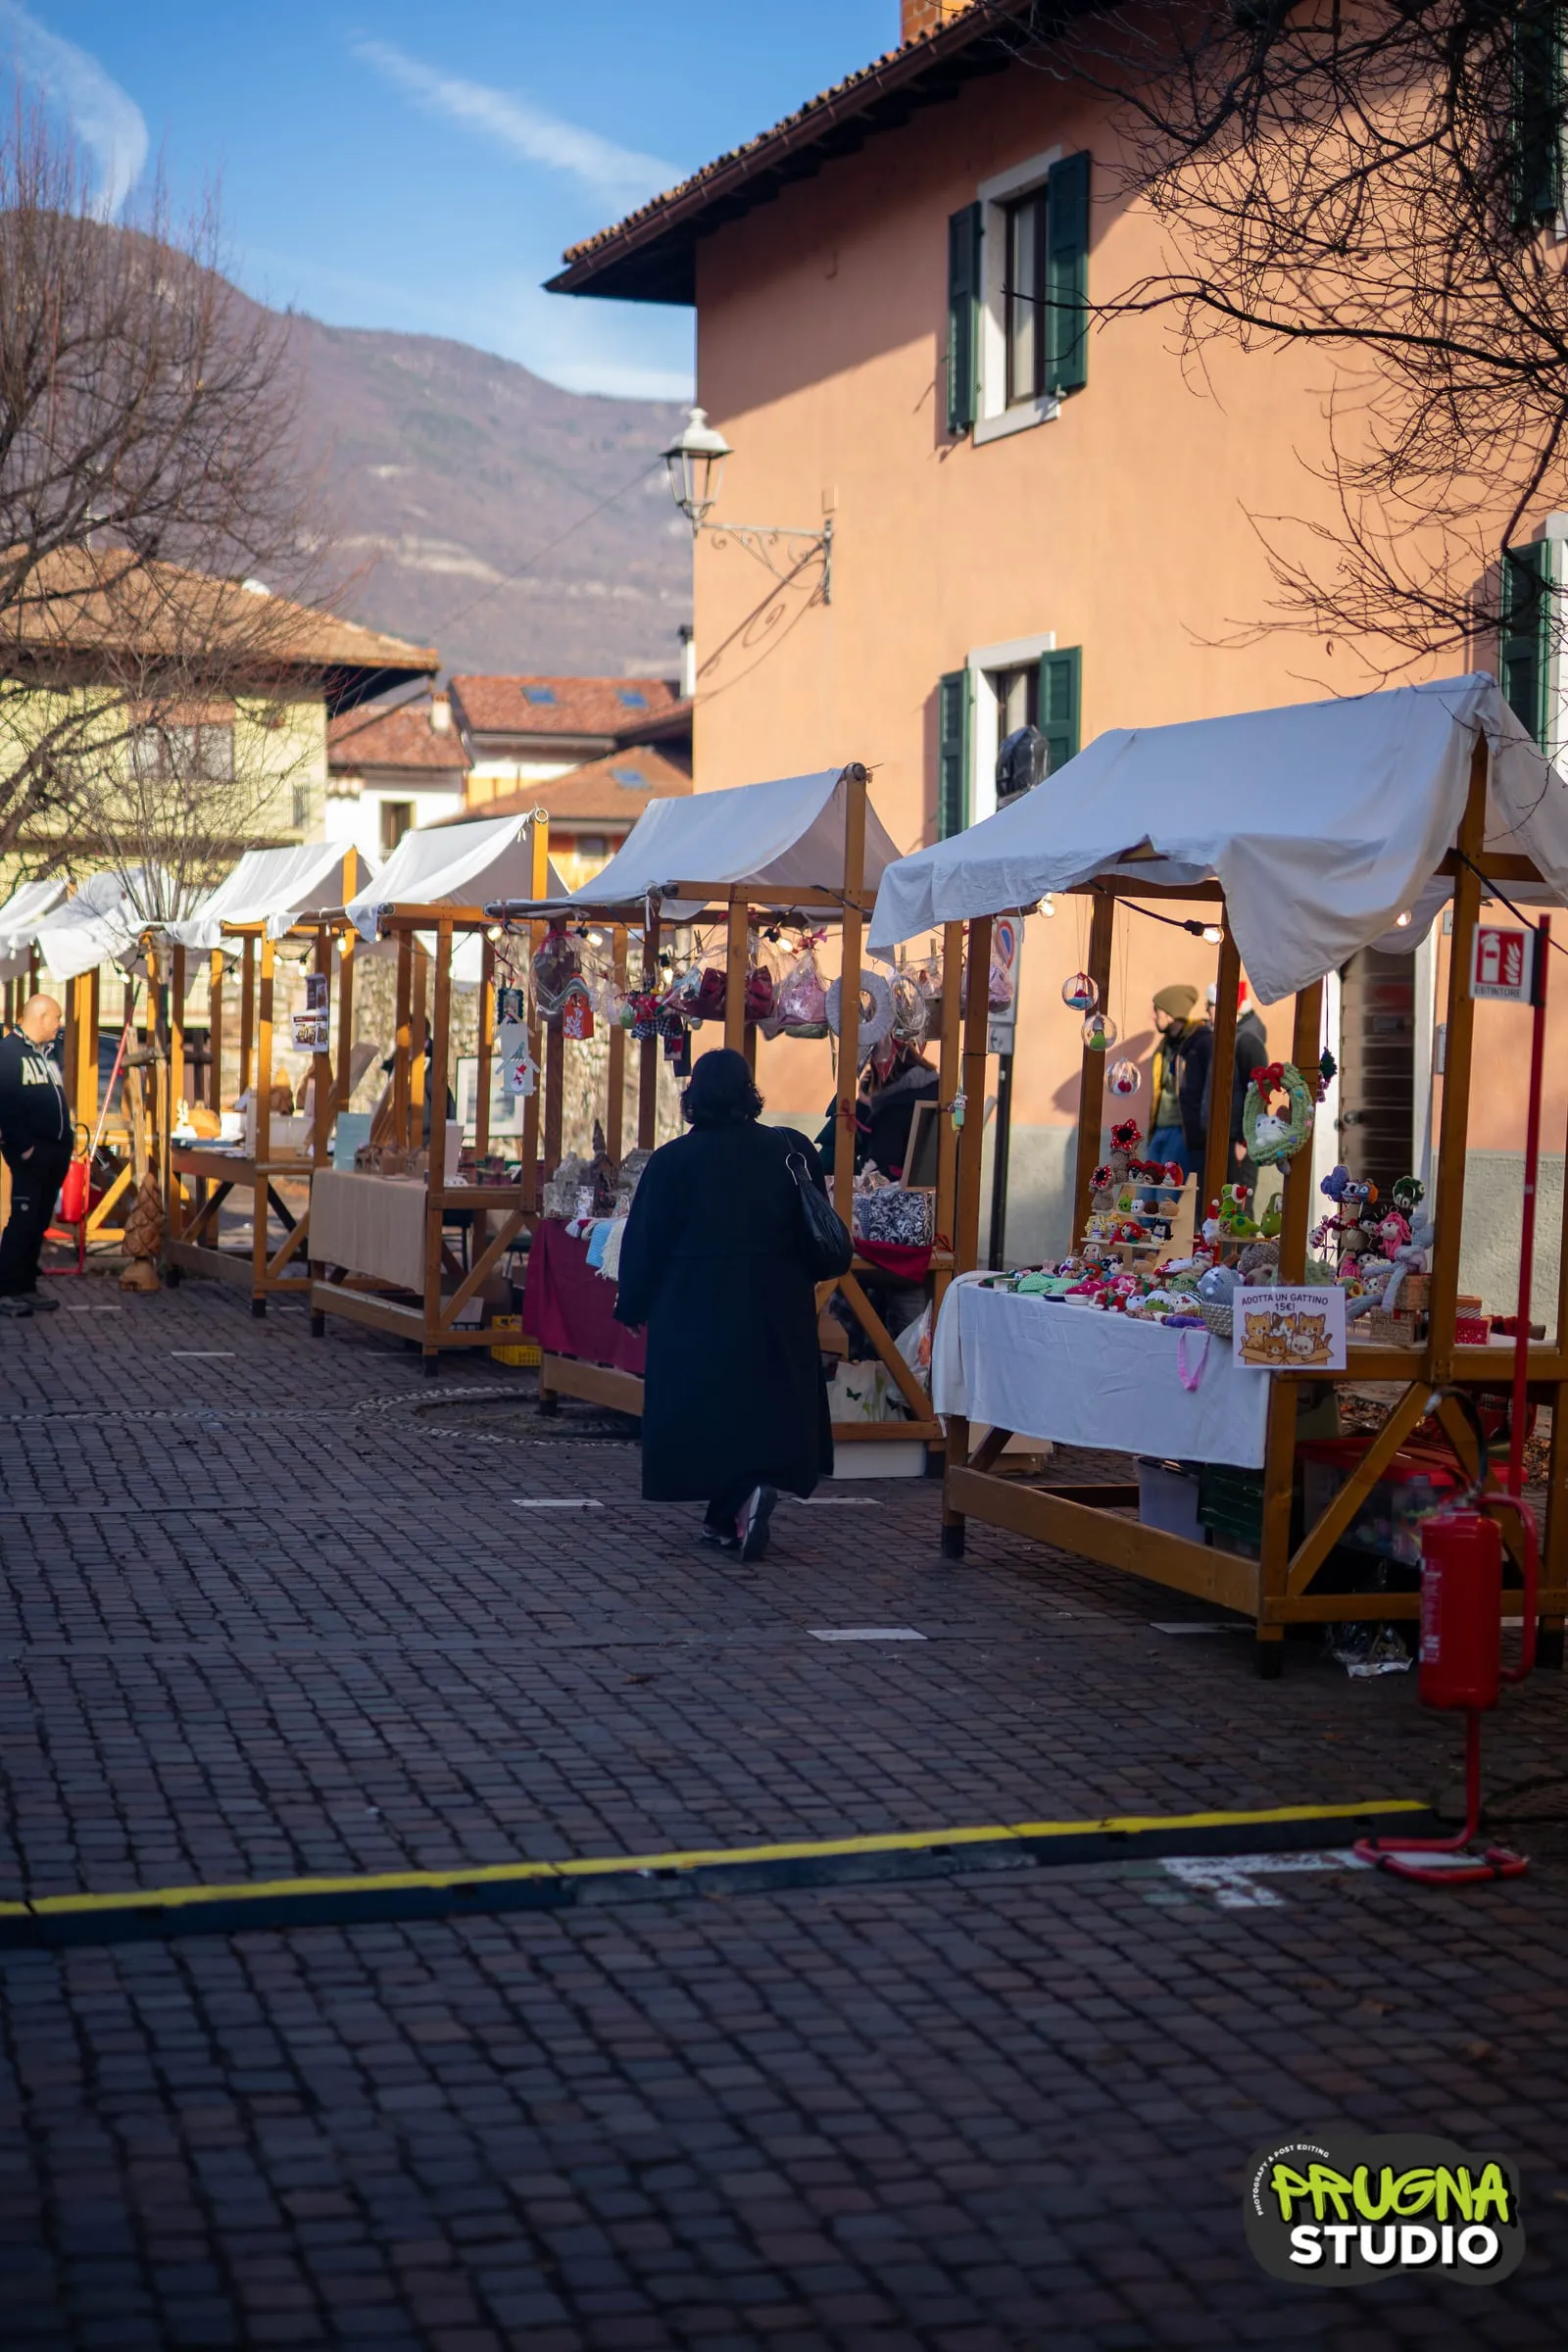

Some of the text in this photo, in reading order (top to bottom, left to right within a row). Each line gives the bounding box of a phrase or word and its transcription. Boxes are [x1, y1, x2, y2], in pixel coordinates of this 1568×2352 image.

[1474, 985, 1522, 998] ESTINTORE
[1242, 1295, 1273, 1305] ADOTTA
[1290, 1294, 1329, 1305] GATTINO
[1275, 1302, 1296, 1311] 15€!
